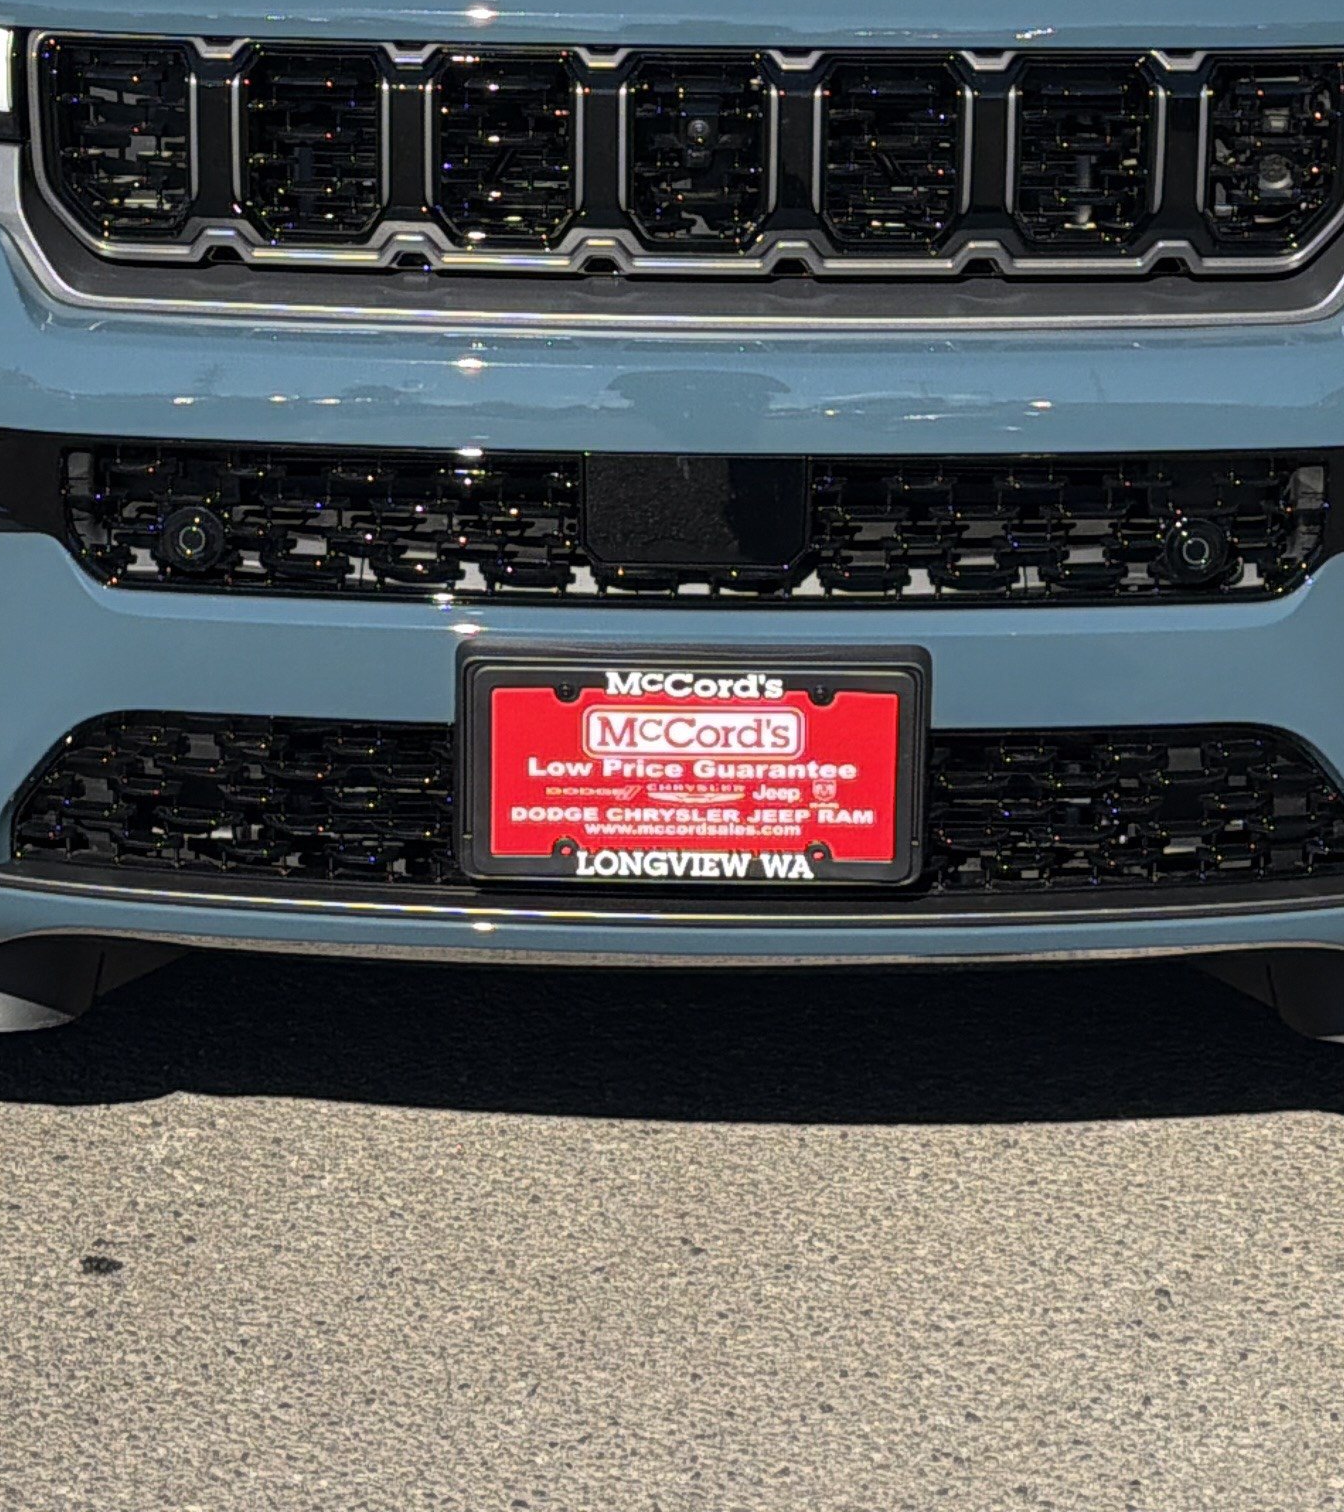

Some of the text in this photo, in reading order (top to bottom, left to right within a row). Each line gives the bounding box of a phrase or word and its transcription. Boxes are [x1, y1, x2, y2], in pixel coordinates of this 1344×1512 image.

[605, 671, 784, 699] McCord's
[597, 716, 790, 748] McCord's
[528, 757, 858, 780] Low Price Guarantee
[752, 784, 801, 803] Jeep
[511, 806, 874, 824] DODGE CHRYSLER JEEP RAM
[584, 823, 801, 836] www.mccordsales.com
[576, 850, 814, 879] LONGVIEW WA
